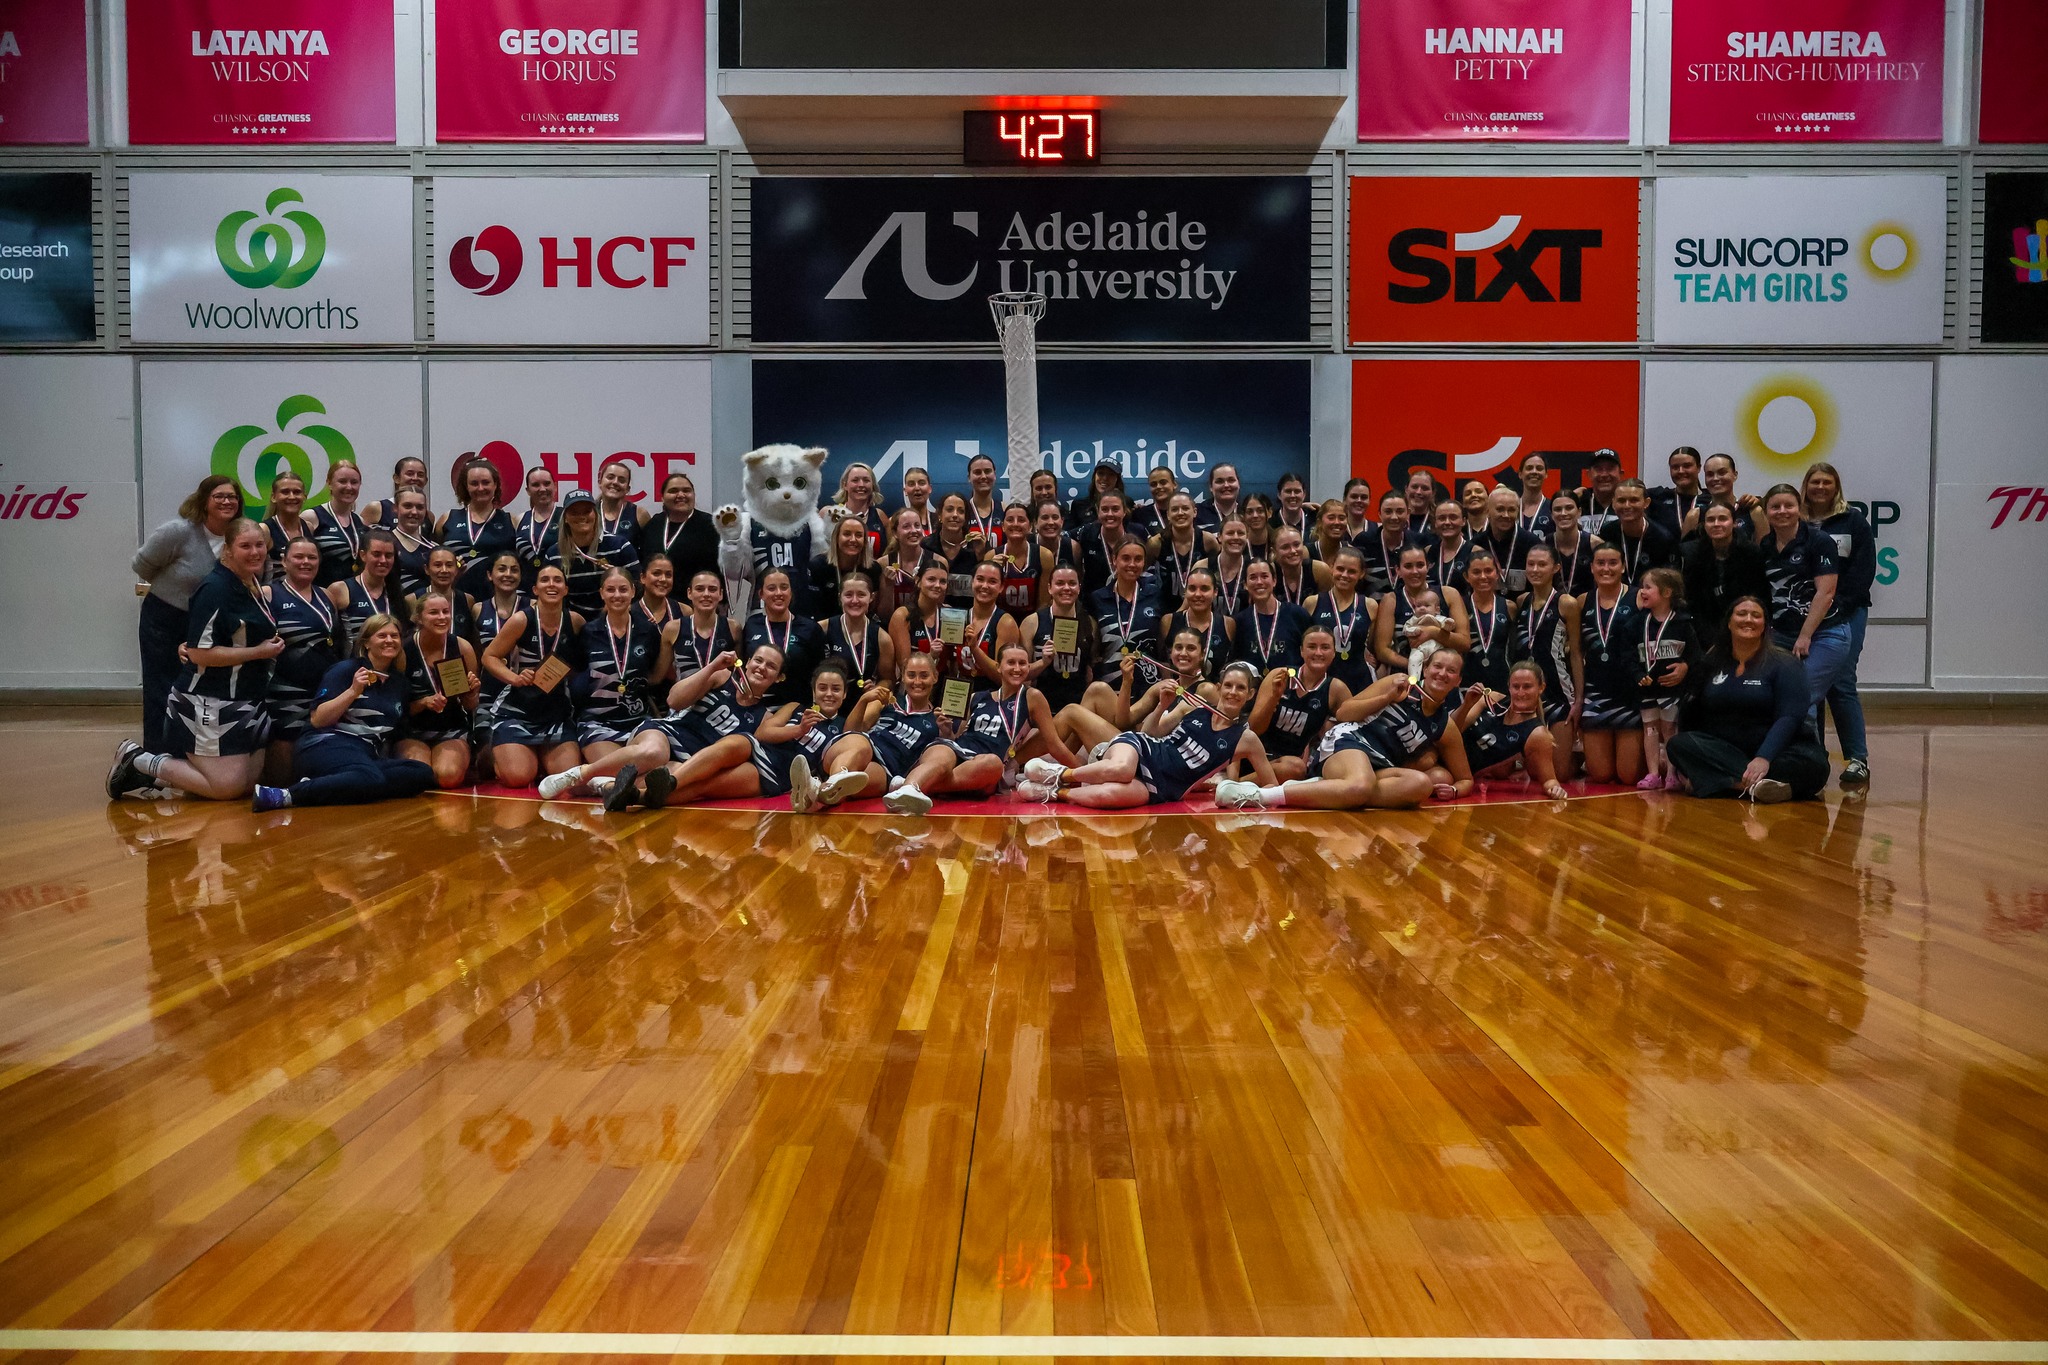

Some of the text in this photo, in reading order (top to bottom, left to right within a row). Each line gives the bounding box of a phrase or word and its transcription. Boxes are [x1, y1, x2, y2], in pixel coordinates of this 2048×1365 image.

[192, 30, 329, 56] LATANYA
[499, 29, 639, 55] GEORGIE
[1426, 28, 1563, 54] HANNAH
[1727, 31, 1885, 57] SHAMERA
[211, 61, 310, 82] WILSON
[522, 60, 617, 86] HORJUS
[1454, 59, 1533, 80] PETTY
[1688, 62, 1924, 83] STERLING-HUMPHREY
[213, 114, 311, 122] CHASING GREATNESS
[521, 113, 619, 122] CHASING GREATNESS
[1444, 112, 1544, 121] CHASING GREATNESS
[1756, 112, 1855, 121] CHASING GREATNESS
[999, 114, 1093, 159] 4:27
[998, 210, 1207, 251] Adelaide
[539, 237, 696, 288] HCF
[1674, 238, 1848, 267] SUNCORP
[998, 259, 1237, 310] University
[1675, 273, 1848, 303] TEAM GIRLS
[185, 299, 359, 330] Woolworths
[1000, 438, 1207, 479] delaide
[770, 542, 794, 567] GA
[1005, 585, 1029, 607] GA
[974, 713, 1002, 738] GA
[1275, 706, 1309, 736] WA
